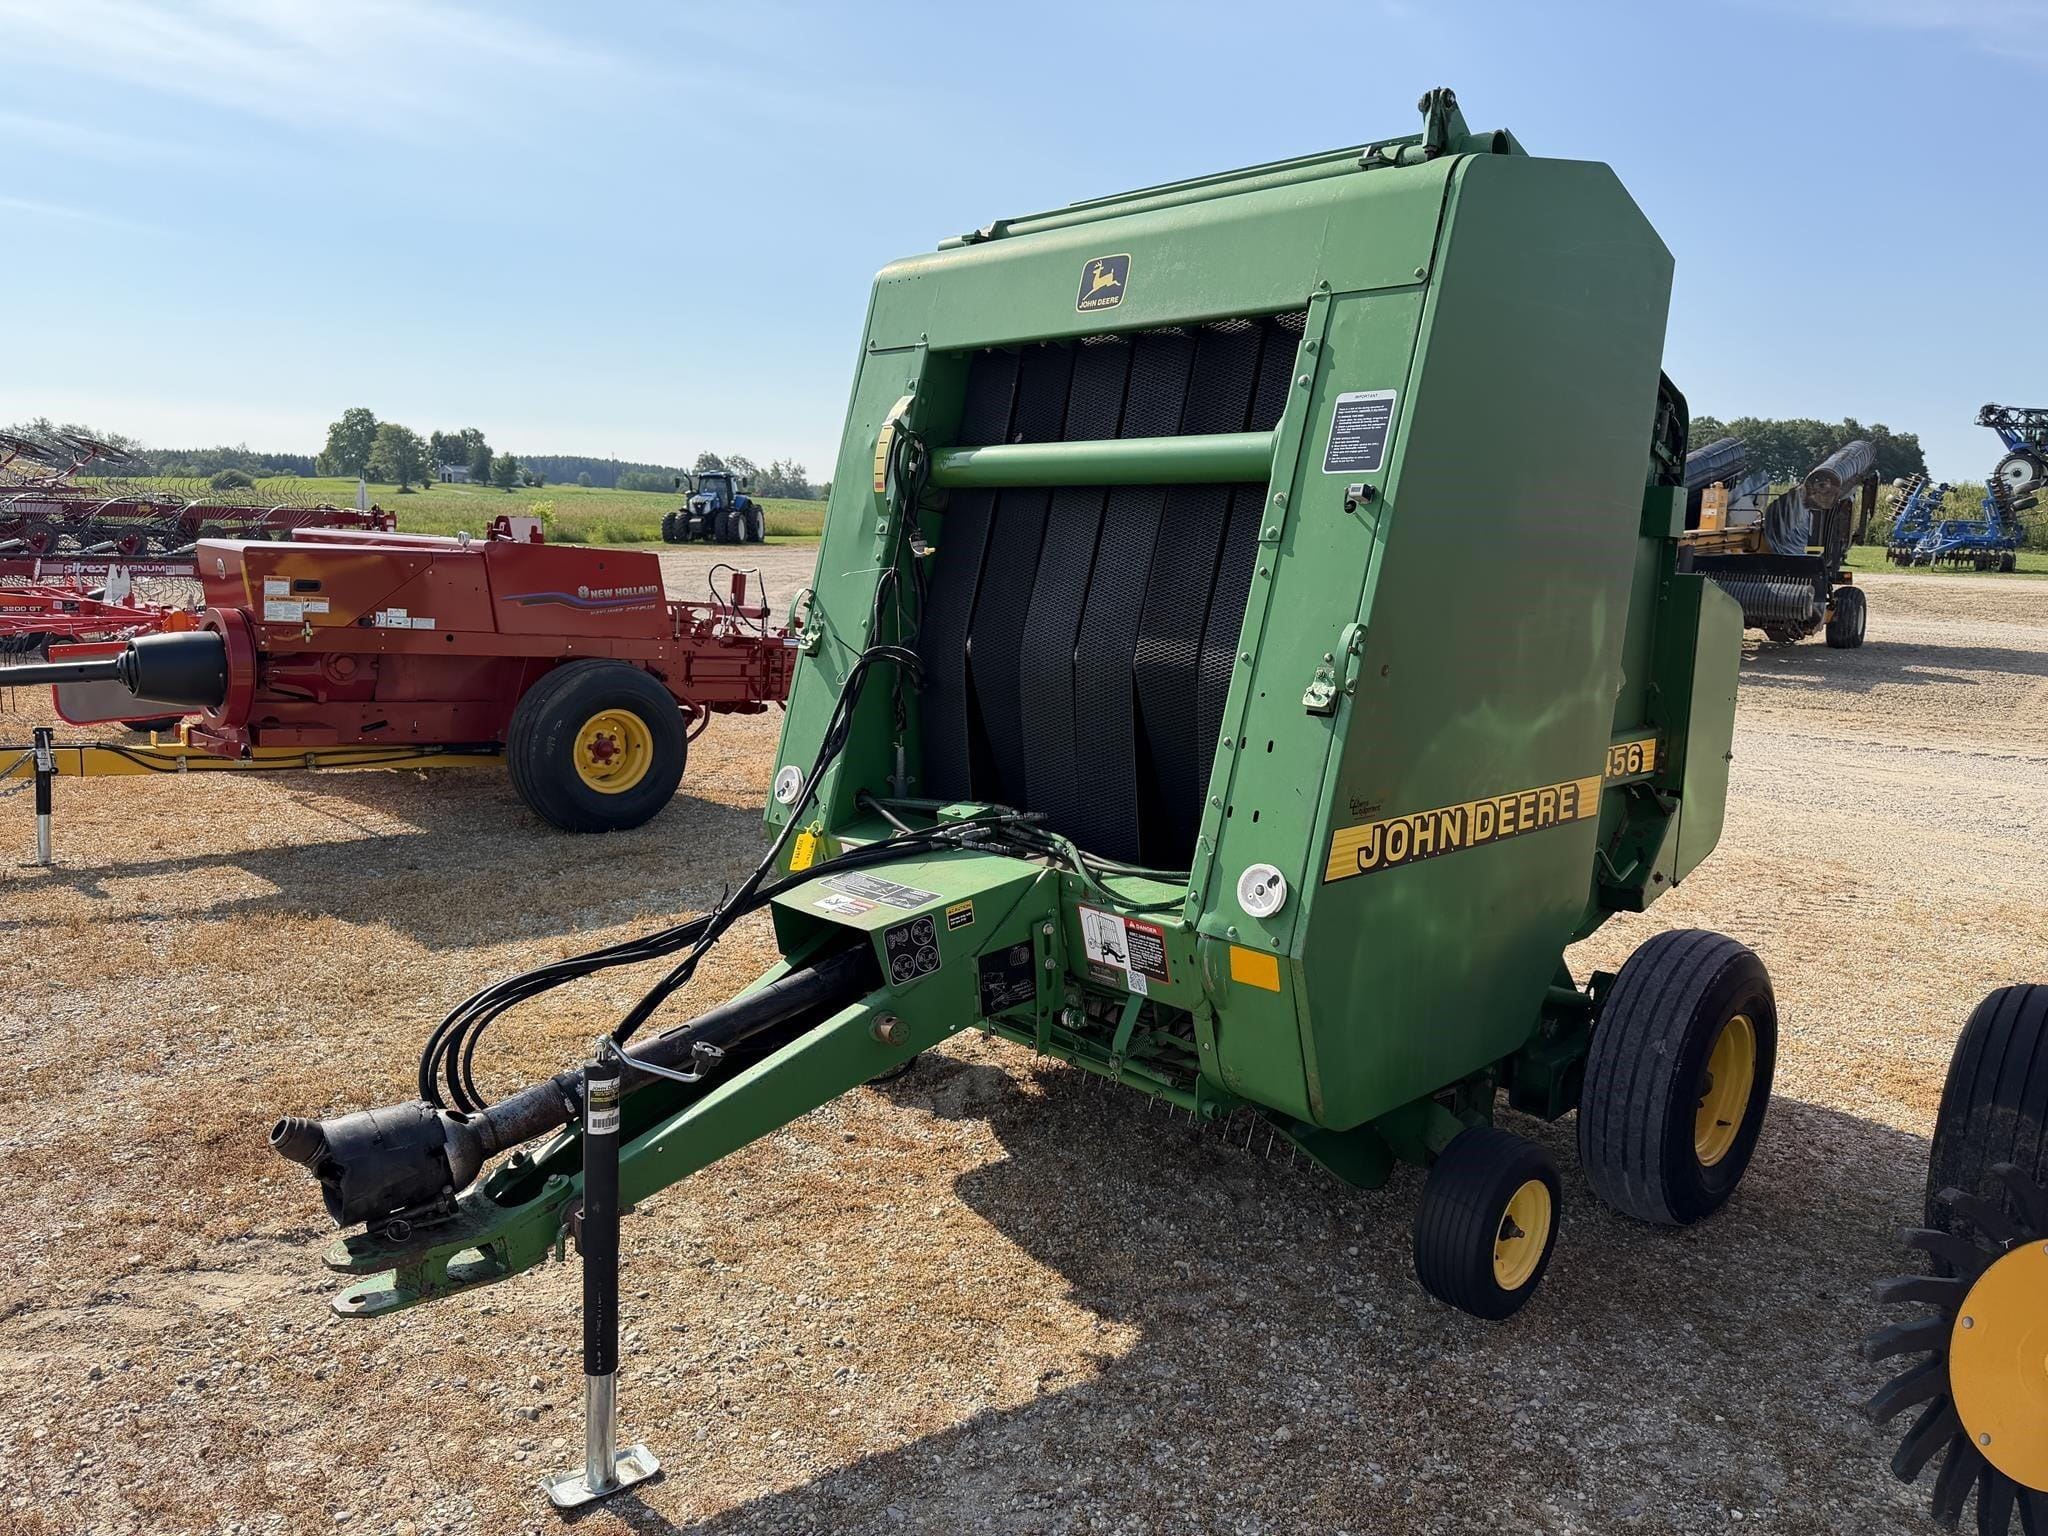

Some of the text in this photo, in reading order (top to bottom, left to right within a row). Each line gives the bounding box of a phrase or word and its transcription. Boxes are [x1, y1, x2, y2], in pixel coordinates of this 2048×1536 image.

[1079, 296, 1120, 309] JOHN DEERE
[590, 585, 659, 599] NEW HOLLAND
[1358, 785, 1579, 869] JOHN DEERE
[1135, 923, 1157, 934] DANGER
